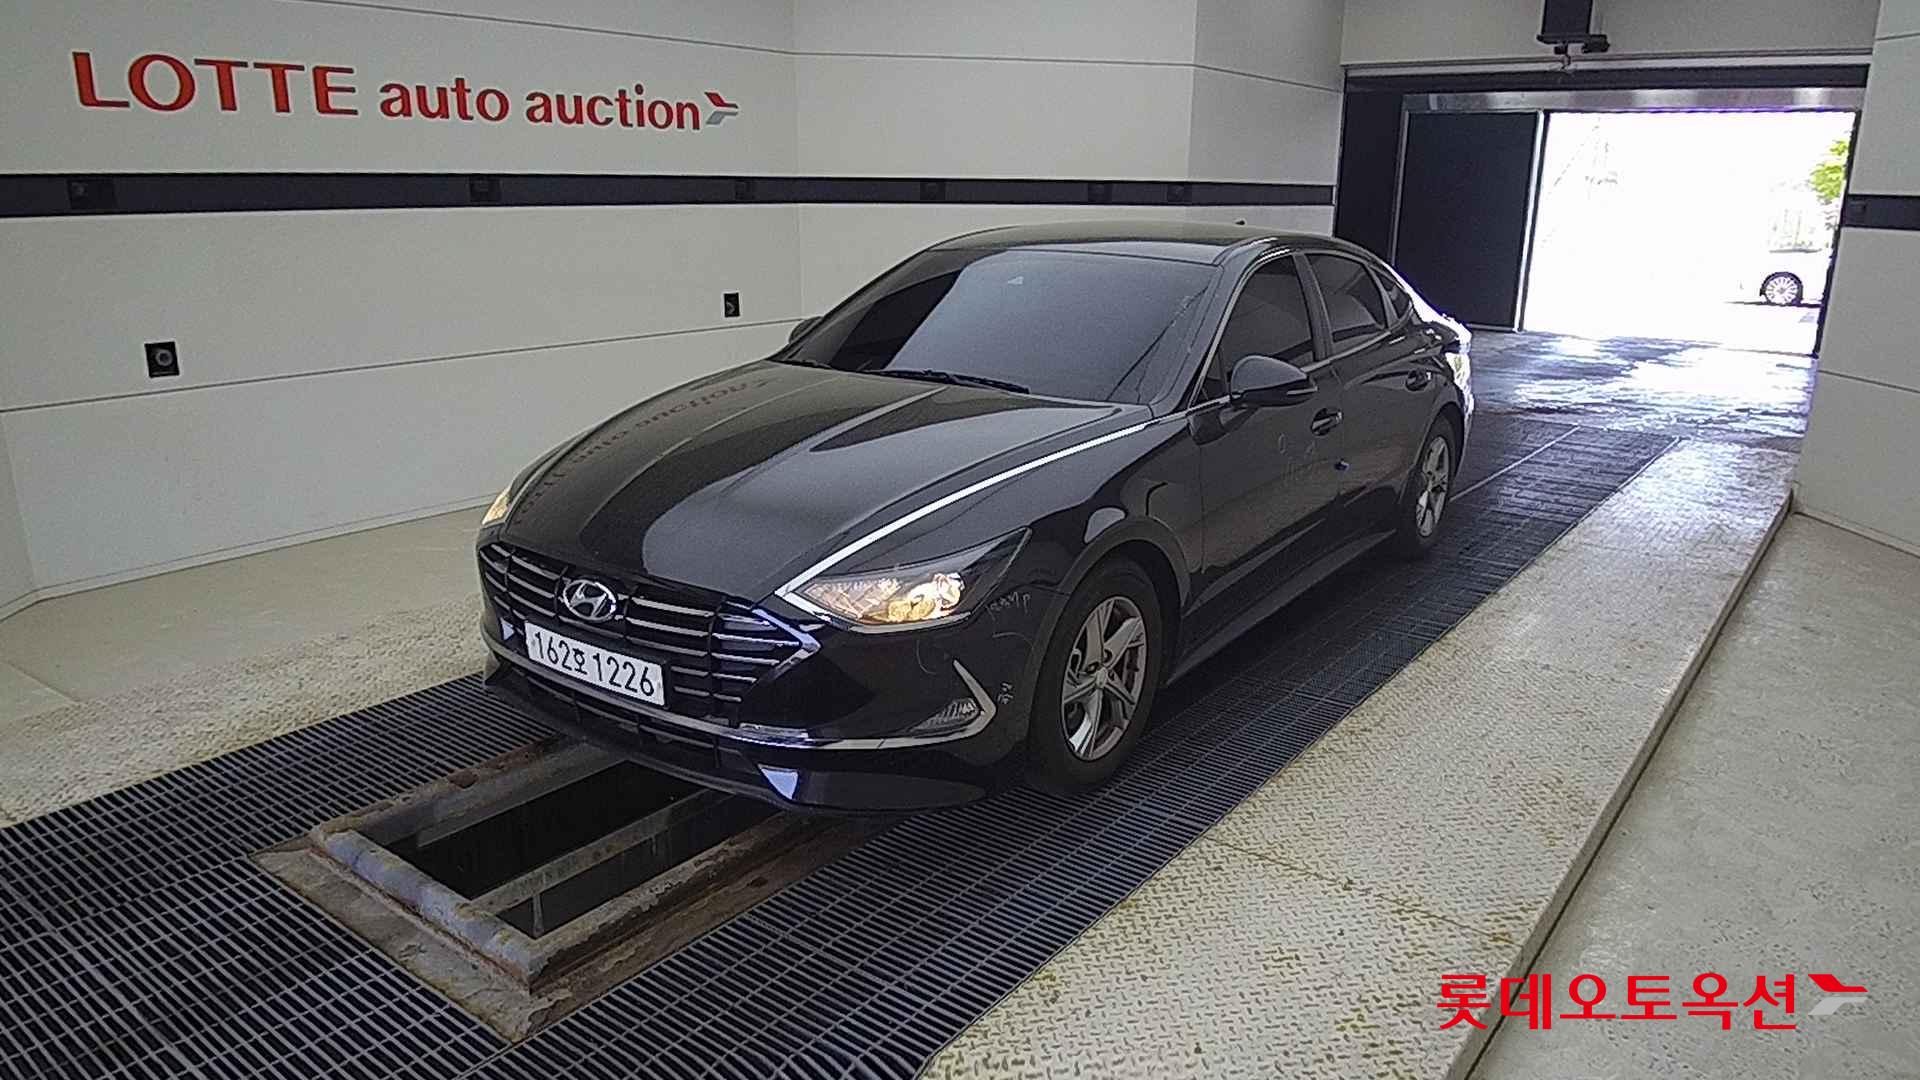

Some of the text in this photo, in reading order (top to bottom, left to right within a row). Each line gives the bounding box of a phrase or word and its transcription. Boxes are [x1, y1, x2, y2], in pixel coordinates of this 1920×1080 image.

[72, 51, 700, 130] LOTTE auto auction
